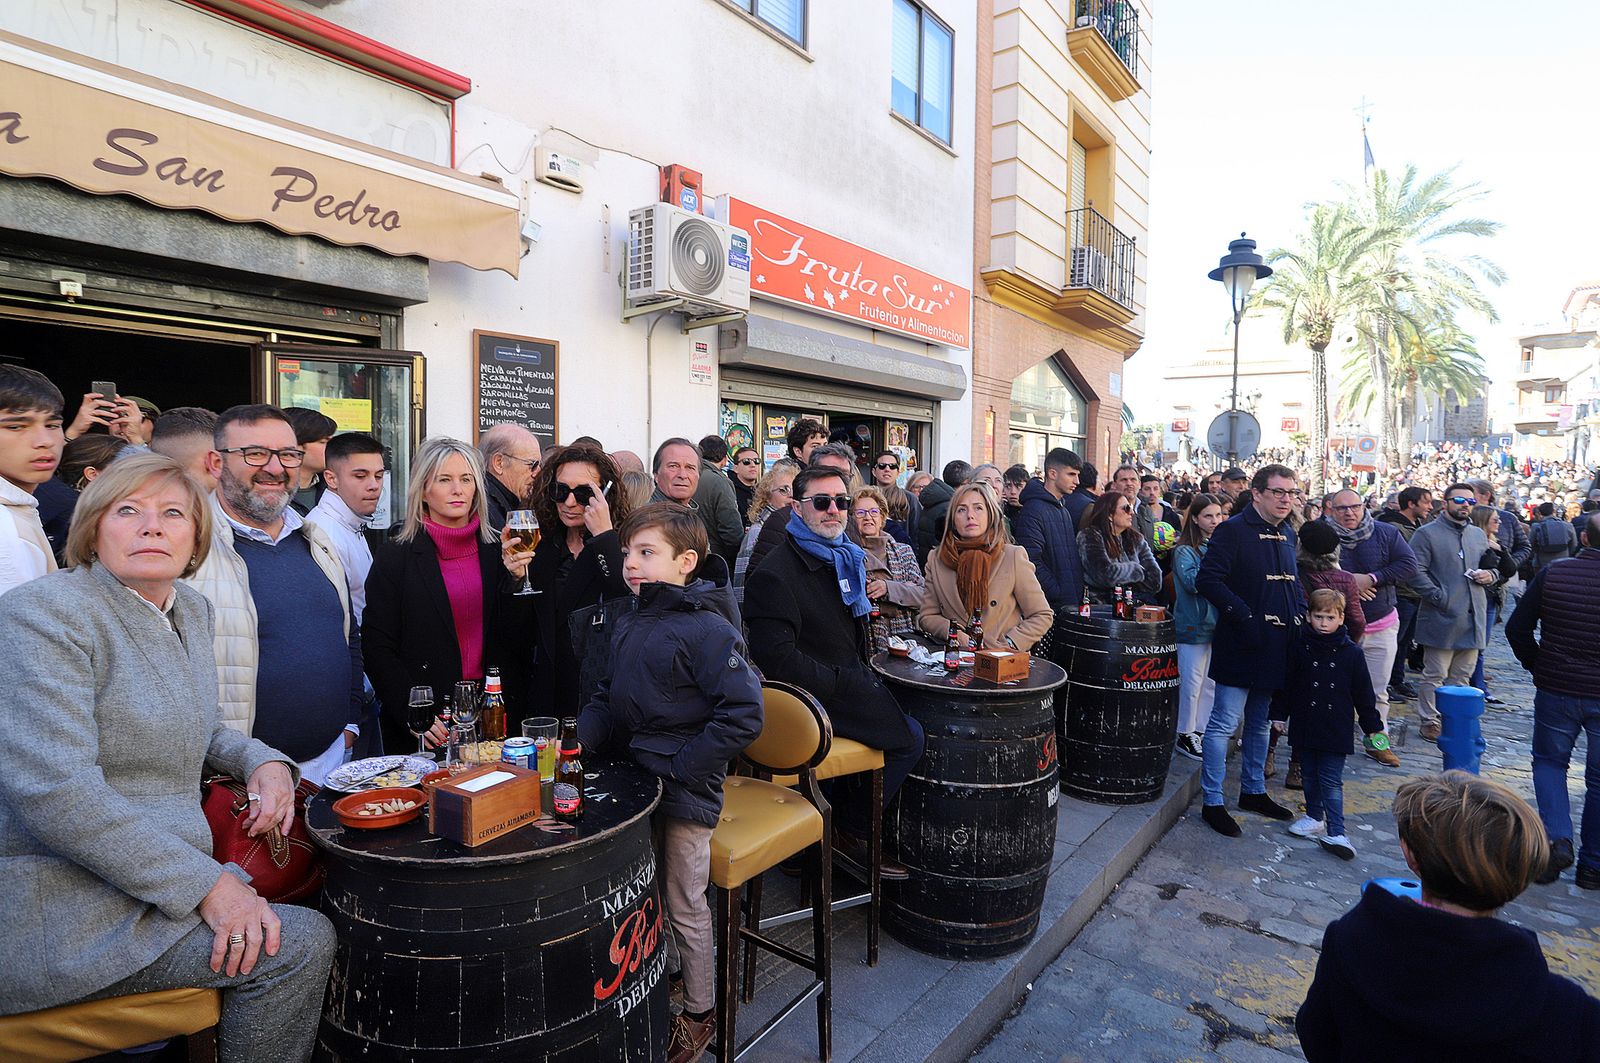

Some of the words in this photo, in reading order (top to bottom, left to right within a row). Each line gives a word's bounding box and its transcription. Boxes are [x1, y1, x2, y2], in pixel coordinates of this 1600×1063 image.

[93, 128, 226, 193] San
[271, 166, 402, 233] Pedro
[753, 218, 877, 297] Fruta
[882, 274, 943, 315] Sur
[859, 301, 899, 325] Fruteria
[900, 316, 907, 329] y
[907, 316, 964, 344] Alimentacion
[480, 408, 528, 419] CHIPIRONES
[478, 822, 506, 839] CERVEZAS
[506, 809, 536, 827] ALHAMBRA
